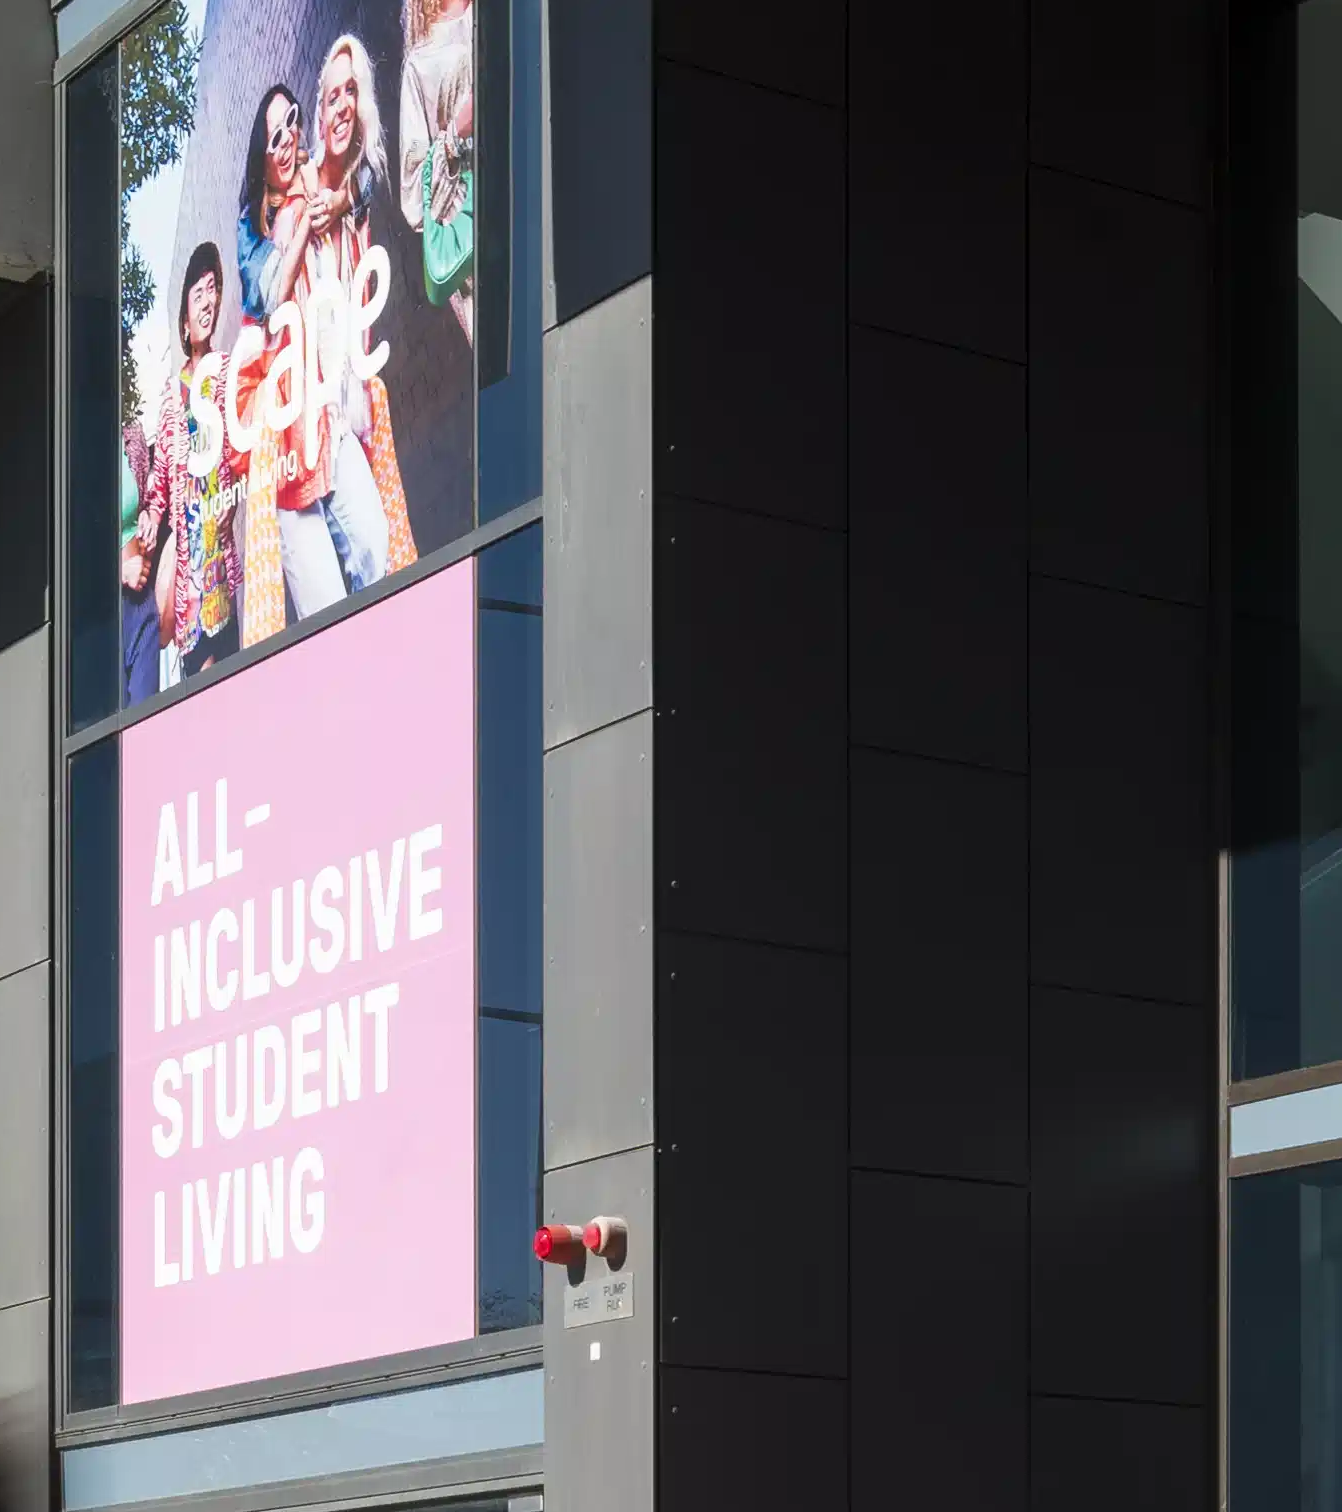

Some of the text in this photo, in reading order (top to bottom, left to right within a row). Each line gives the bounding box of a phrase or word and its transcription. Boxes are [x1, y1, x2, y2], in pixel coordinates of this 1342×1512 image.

[187, 244, 391, 478] scape
[151, 777, 271, 906] ALL-
[153, 822, 444, 1033] INCLUSIVE
[151, 981, 399, 1160] STUDENT
[153, 1146, 327, 1289] LIVING
